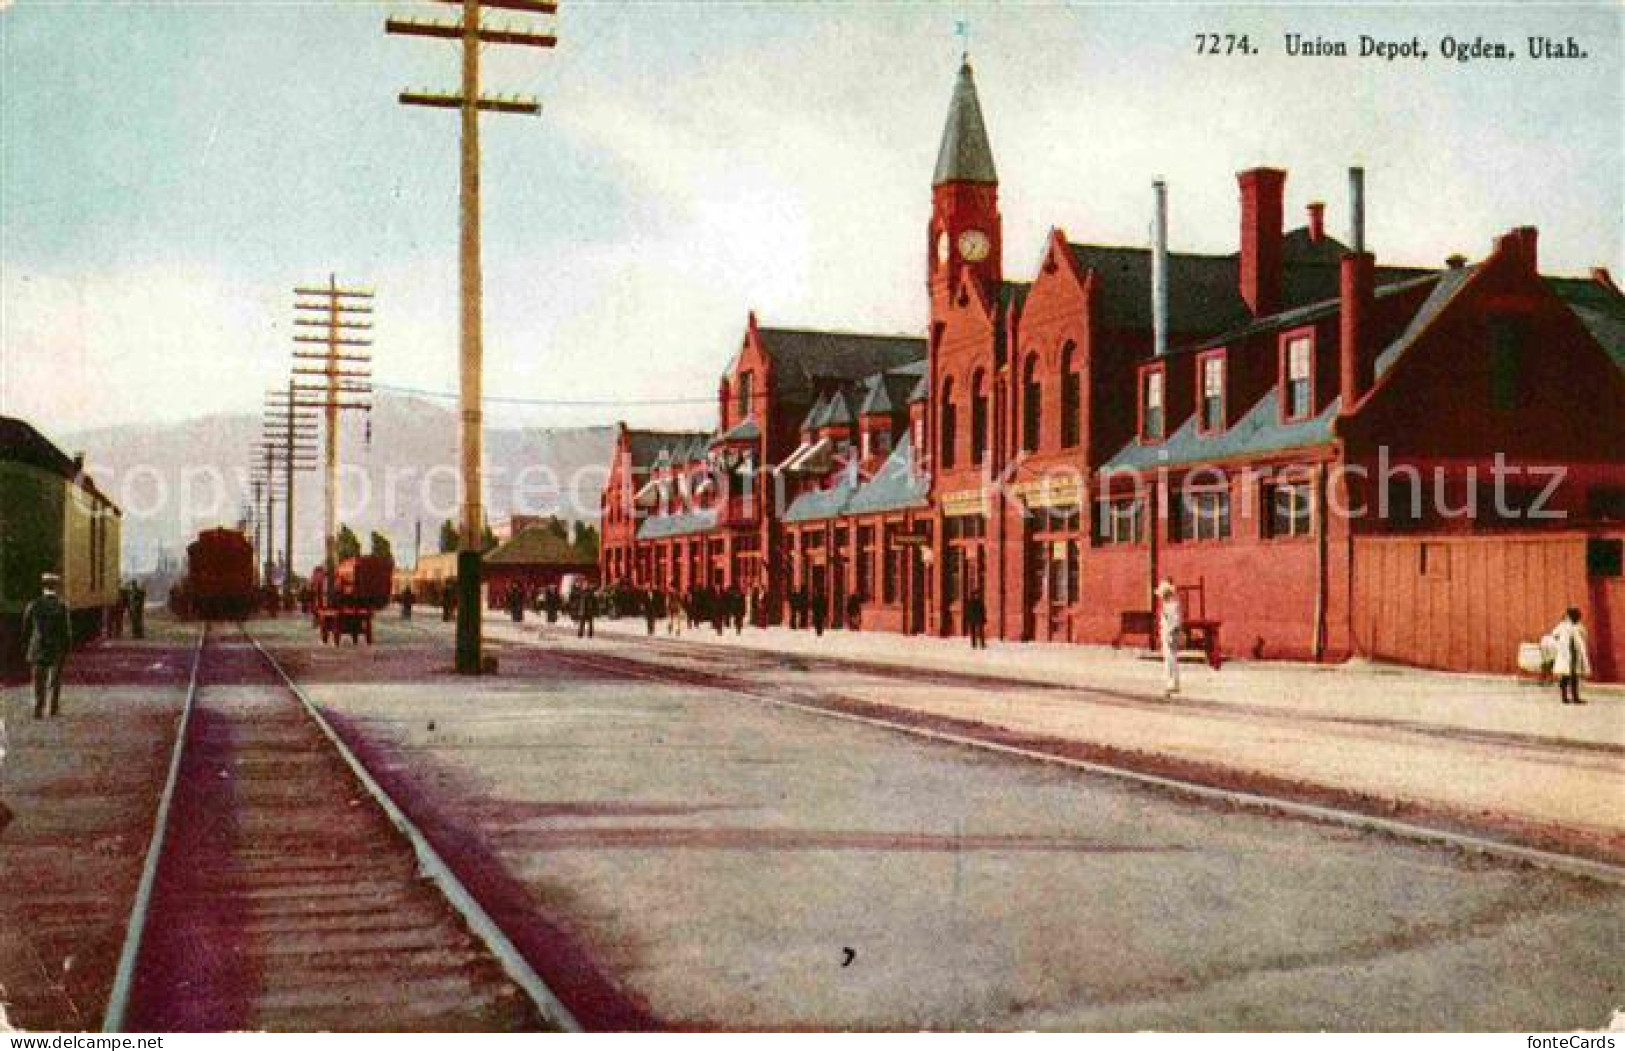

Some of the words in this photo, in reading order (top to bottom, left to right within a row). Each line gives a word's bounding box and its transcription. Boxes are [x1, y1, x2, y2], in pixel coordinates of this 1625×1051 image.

[1195, 34, 1259, 55] 7274.
[1285, 34, 1347, 56] Union
[1359, 34, 1429, 61] Depot,
[1527, 36, 1589, 59] Utah.
